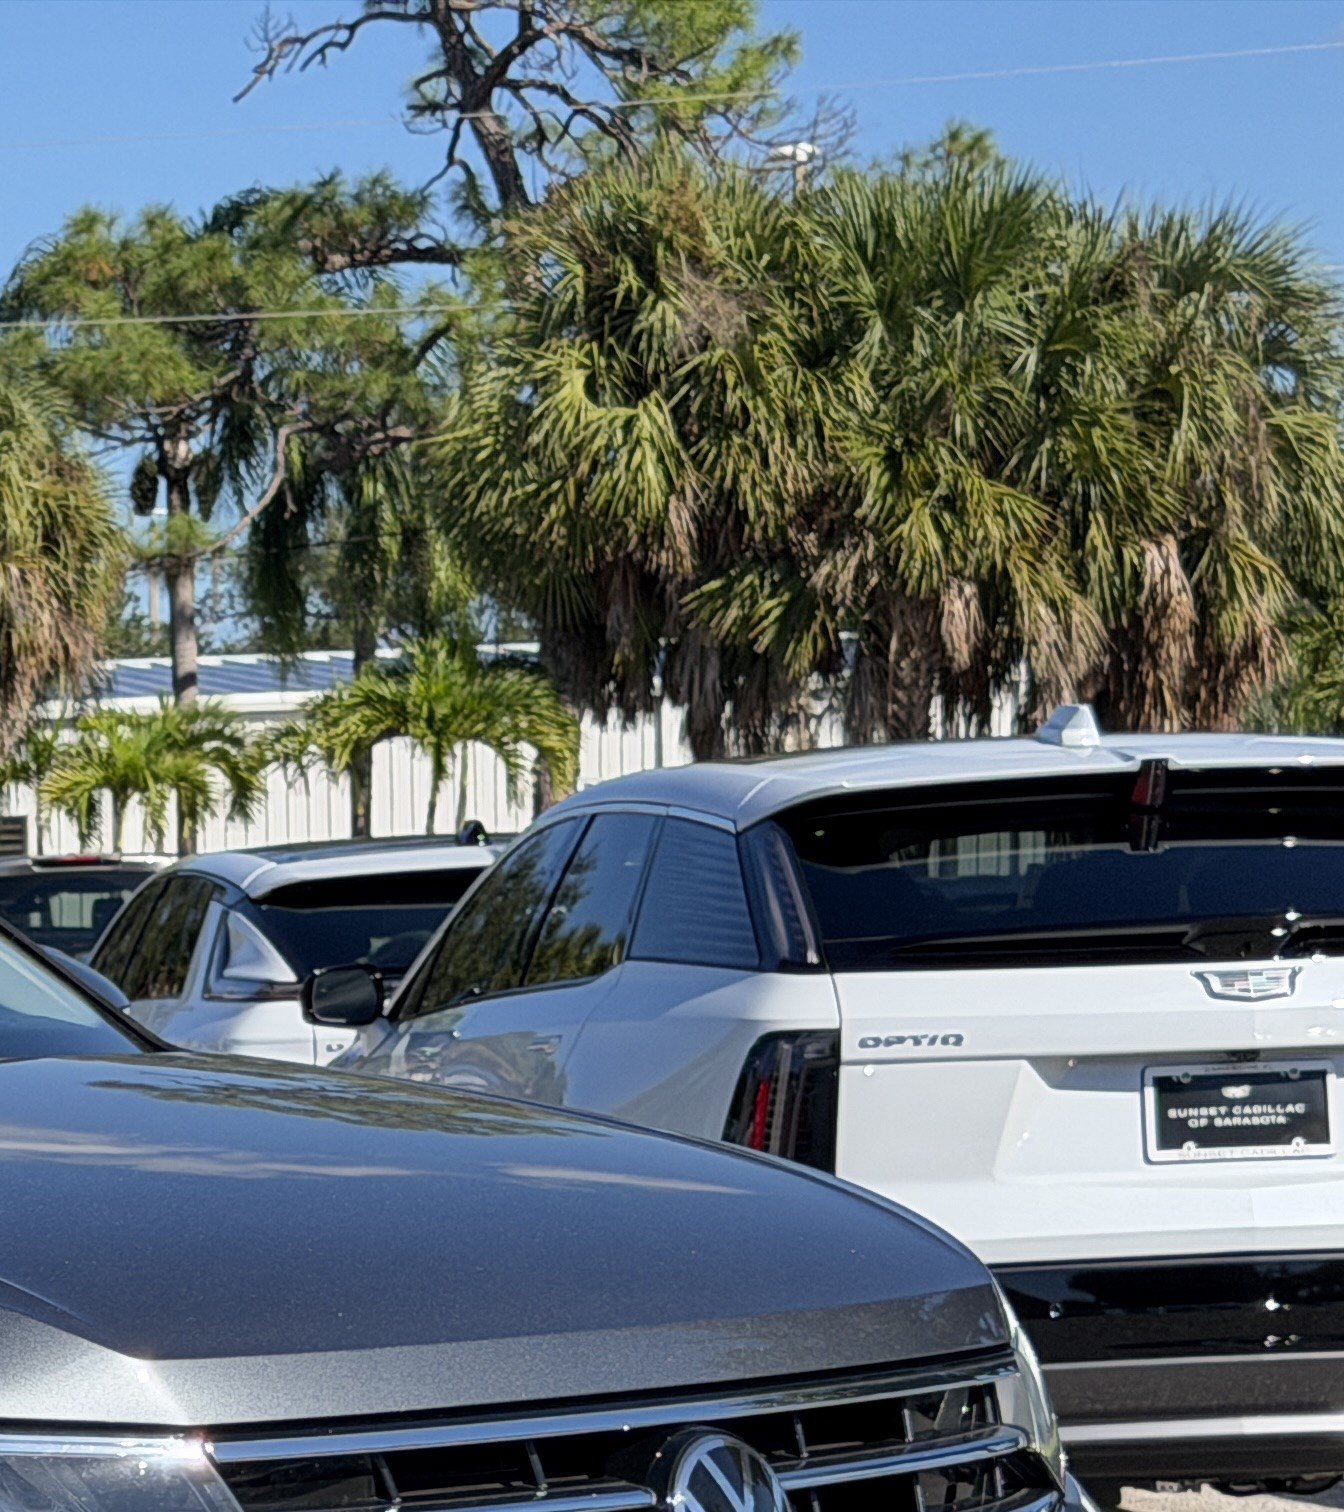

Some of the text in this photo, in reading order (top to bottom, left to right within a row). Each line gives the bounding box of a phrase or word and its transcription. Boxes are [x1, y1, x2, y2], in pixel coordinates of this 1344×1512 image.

[858, 1033, 965, 1049] OPTIQ
[1167, 1102, 1307, 1119] SUNSET CADILLAC
[1187, 1114, 1288, 1129] OF SARASOTA
